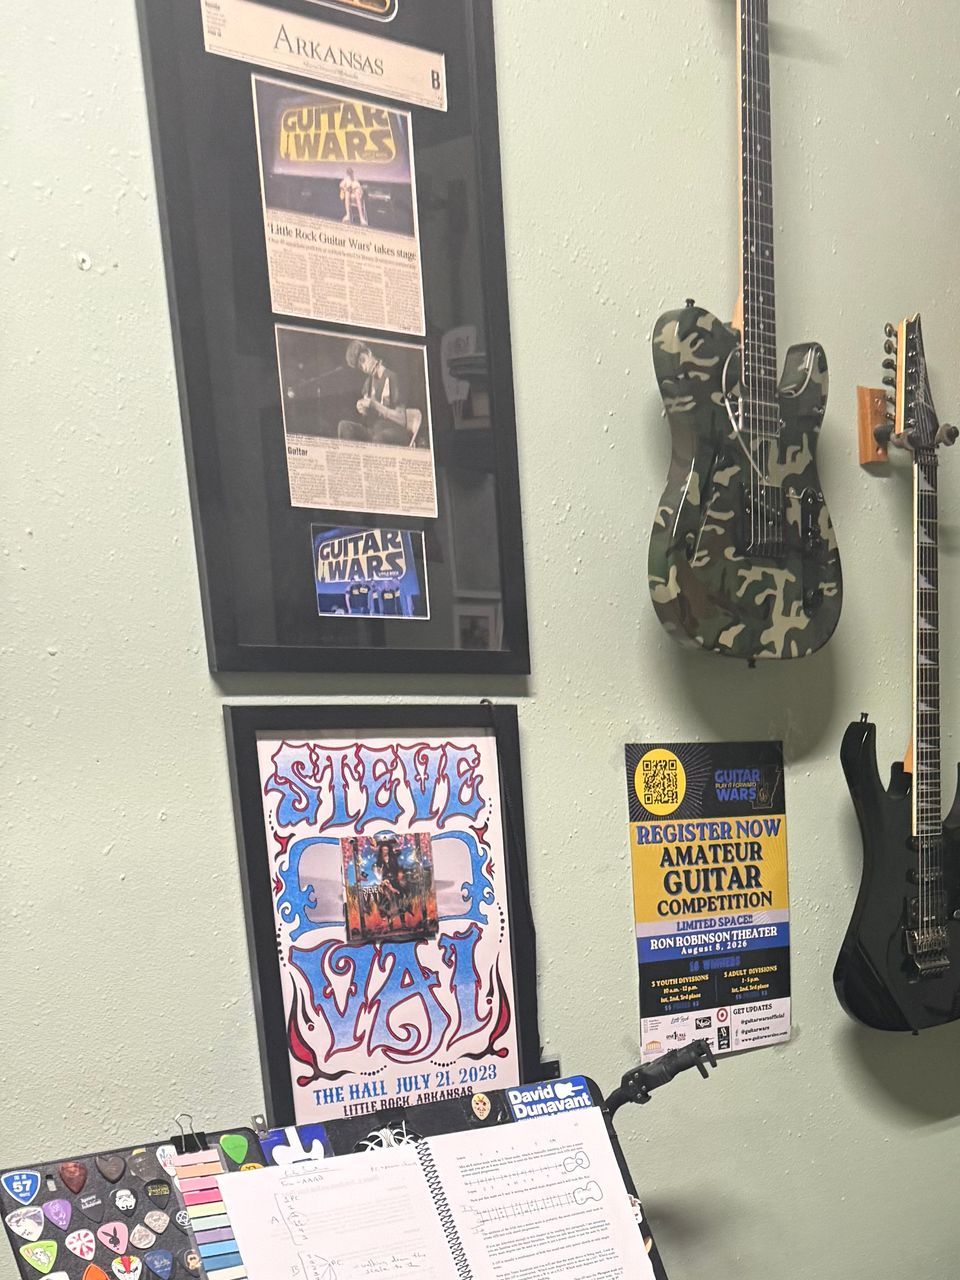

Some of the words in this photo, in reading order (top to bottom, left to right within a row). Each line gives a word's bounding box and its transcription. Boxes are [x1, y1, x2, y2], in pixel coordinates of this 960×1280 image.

[273, 24, 384, 76] ARKANSAS
[431, 69, 440, 90] B
[283, 102, 390, 132] GUITAR
[294, 130, 393, 160] WARS
[295, 228, 317, 243] Rock
[319, 232, 346, 247] Guitar
[374, 243, 394, 255] takes
[397, 247, 417, 261] stage
[320, 529, 402, 560] GUITAR
[328, 551, 404, 581] WARS
[264, 741, 486, 833] STEVE
[714, 768, 760, 783] GUITAR
[716, 787, 757, 801] WARS
[636, 821, 733, 845] REGISTER
[736, 818, 781, 839] NOW
[660, 841, 763, 868] AMATEUR
[663, 864, 763, 896] GUITAR
[657, 891, 773, 917] COMPETITION
[650, 937, 674, 950] RON
[676, 931, 731, 947] ROBINSON
[731, 926, 777, 941] THEATER
[676, 917, 717, 932] LIMITED
[681, 945, 713, 955] August
[727, 940, 748, 950] 2026
[656, 978, 678, 986] YOUTH
[679, 974, 709, 983] DIVISIONS
[728, 969, 747, 977] ADULT
[748, 965, 778, 975] DIVISIONS
[290, 923, 493, 1064] VAI
[733, 1007, 745, 1015] GET
[745, 1003, 773, 1013] UPDATES
[313, 1087, 345, 1106] THE
[349, 1080, 389, 1100] HALL
[396, 1073, 431, 1095] JULY
[458, 1063, 497, 1083] 2023
[508, 1084, 555, 1104] David
[343, 1101, 378, 1117] LITTLE
[416, 1086, 474, 1105] ARKANSAS
[513, 1092, 592, 1119] Dunavant
[12, 1180, 32, 1193] 57
